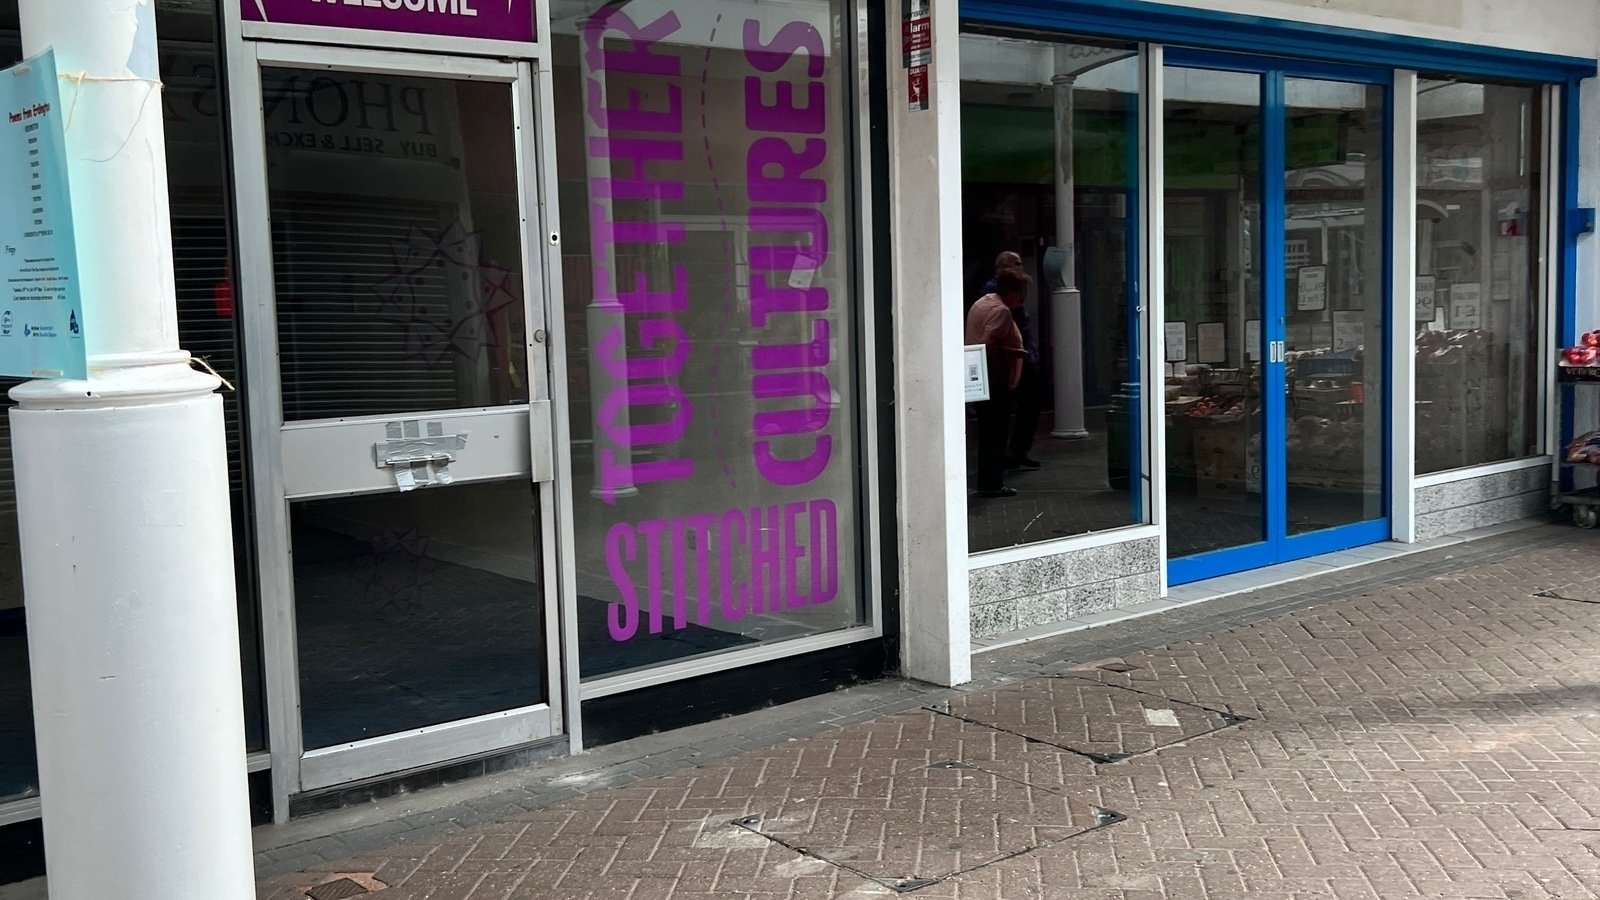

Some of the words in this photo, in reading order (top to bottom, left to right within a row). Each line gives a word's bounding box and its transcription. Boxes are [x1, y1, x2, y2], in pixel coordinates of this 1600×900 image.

[311, 0, 478, 16] COME
[585, 6, 696, 505] TOGETHER
[743, 19, 834, 487] CULTURES
[604, 498, 839, 643] STITCHED
